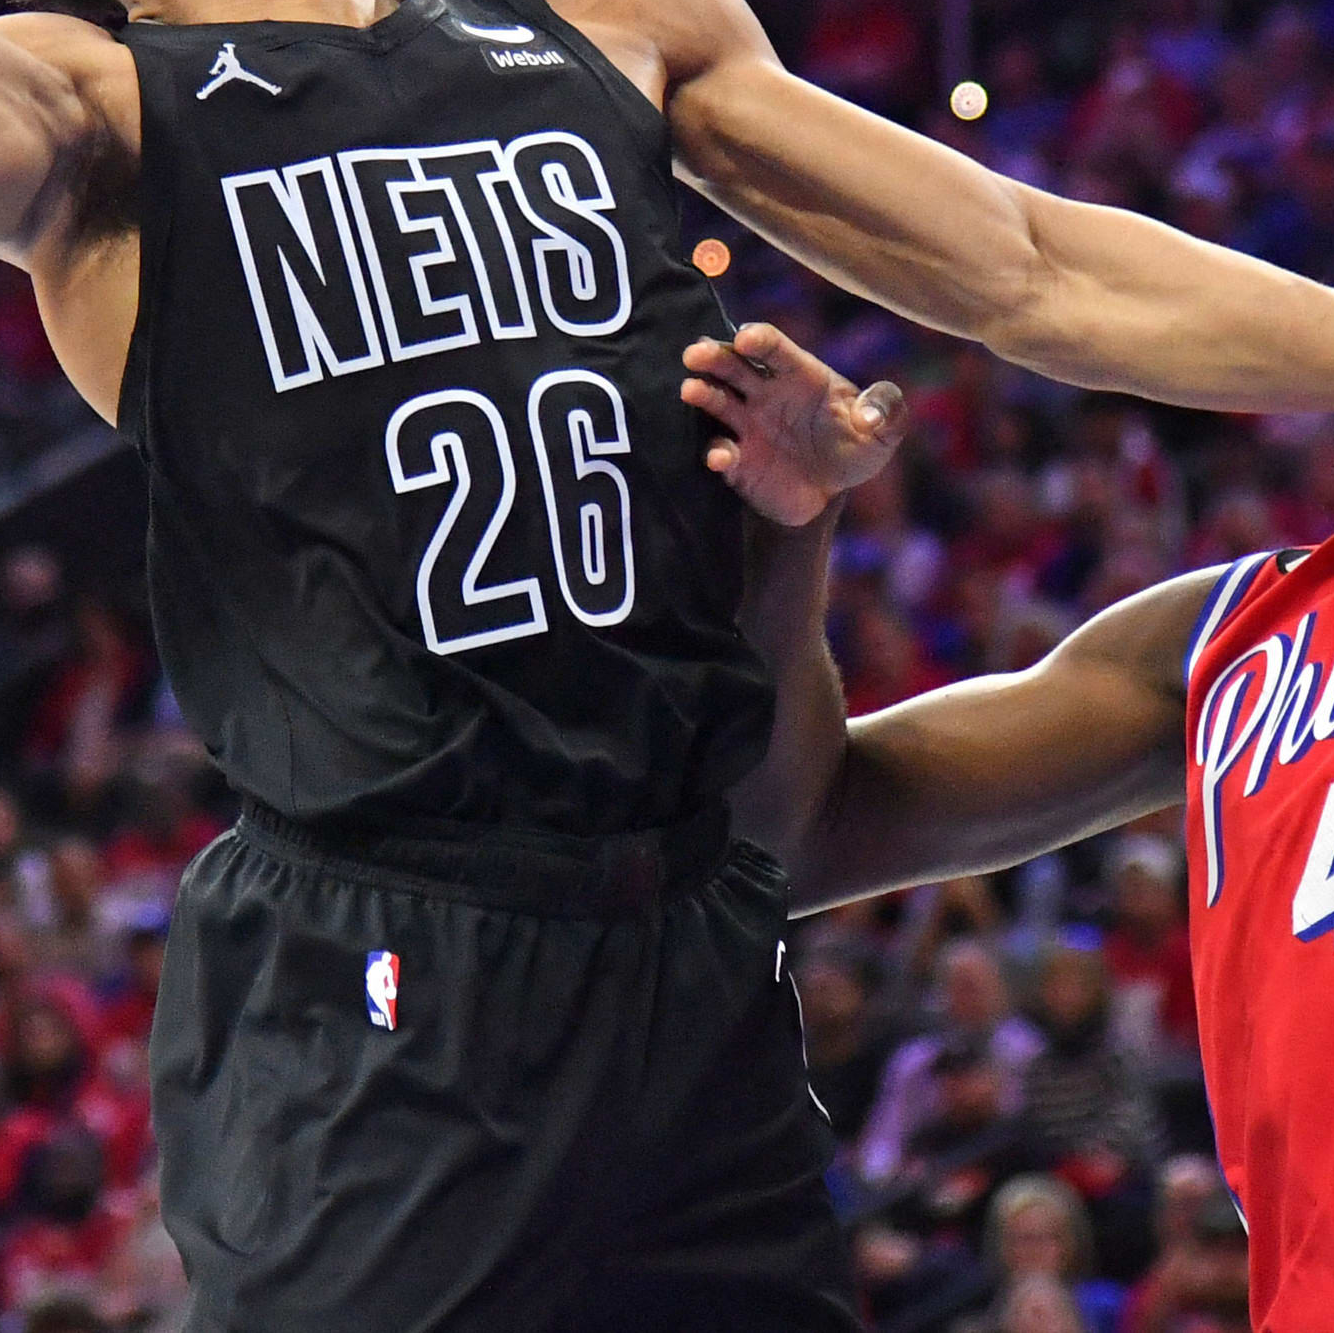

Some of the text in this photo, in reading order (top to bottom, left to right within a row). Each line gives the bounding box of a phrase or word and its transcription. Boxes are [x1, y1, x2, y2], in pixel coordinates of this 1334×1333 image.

[490, 50, 565, 68] Webull
[221, 131, 632, 393] NETS
[384, 369, 636, 656] 26
